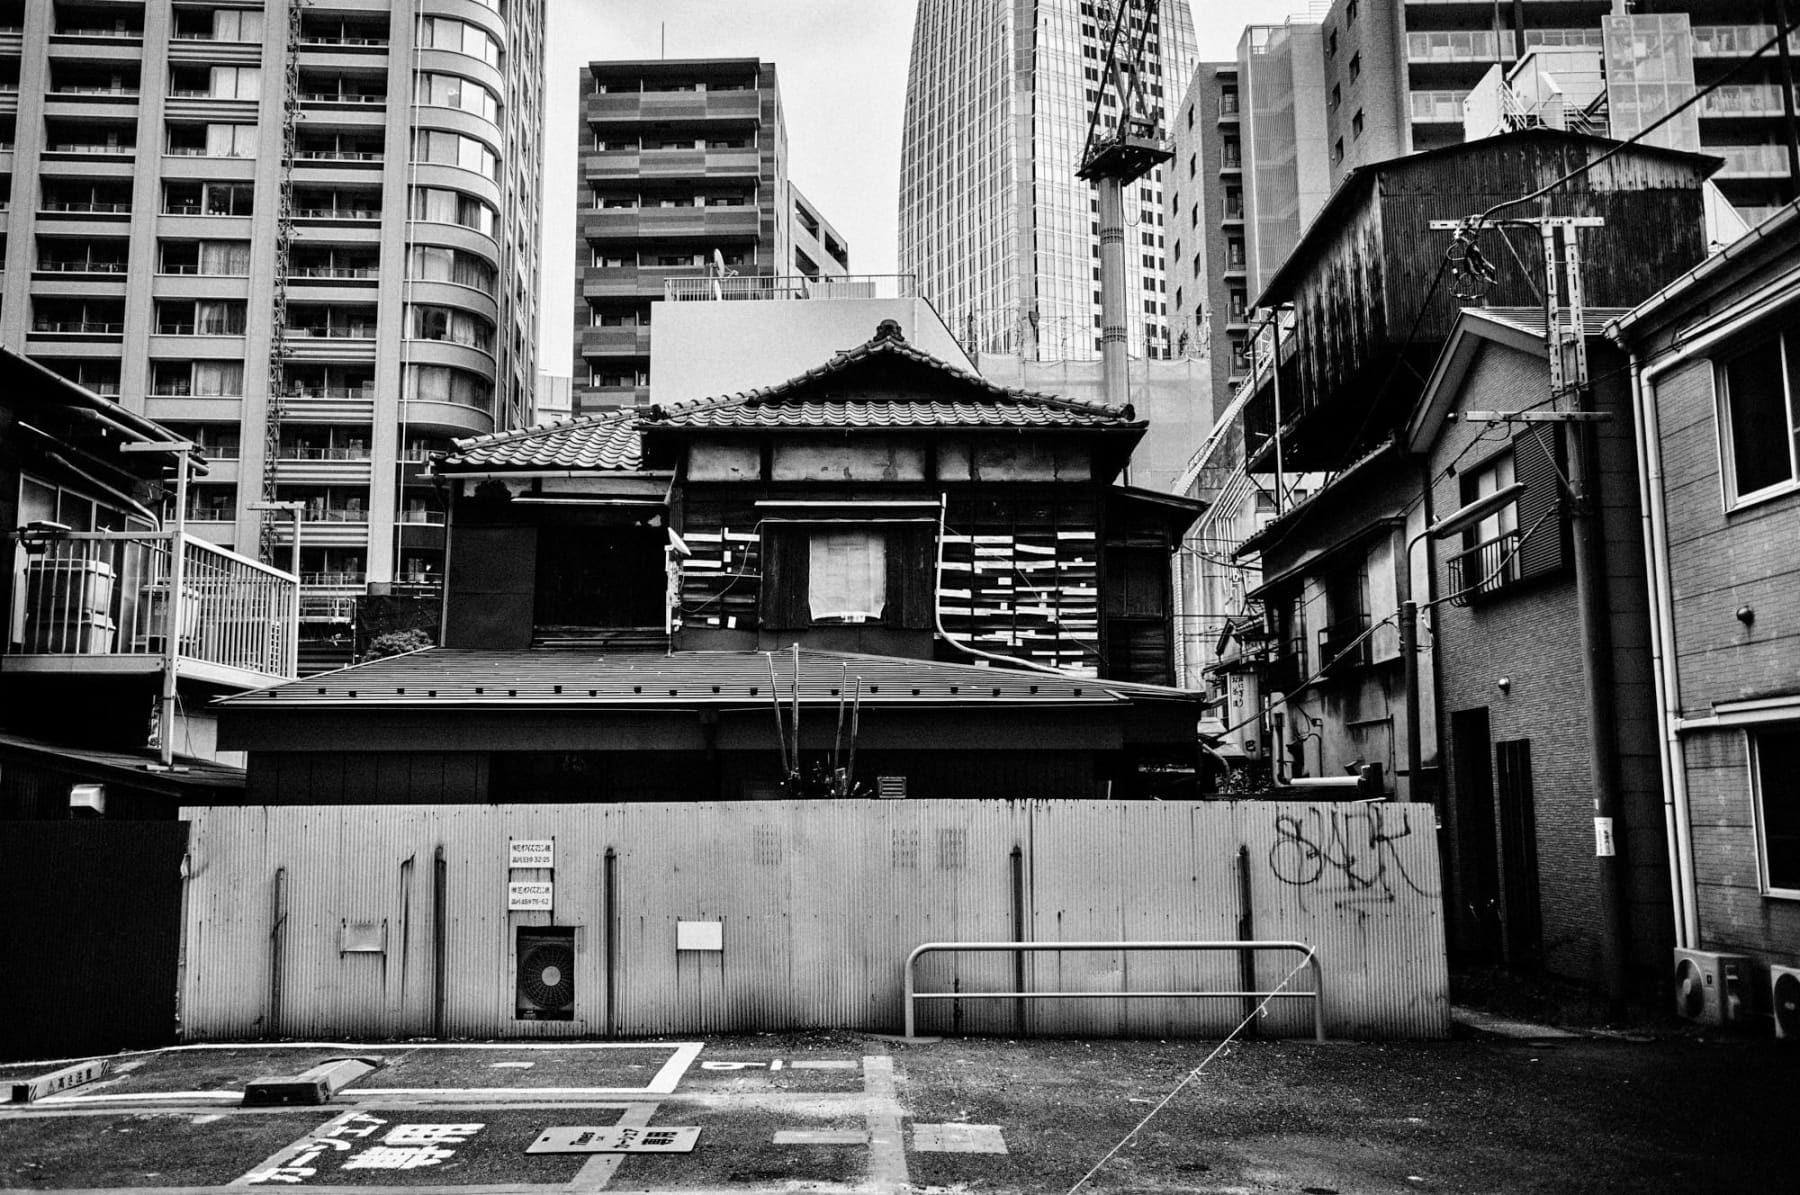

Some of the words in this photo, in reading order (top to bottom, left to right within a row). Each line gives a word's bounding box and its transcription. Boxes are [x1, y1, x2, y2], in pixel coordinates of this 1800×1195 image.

[244, 1112, 388, 1184] カーシェア
[340, 1123, 485, 1170] 専用
[612, 1128, 640, 1149] カーシェア
[641, 1131, 678, 1146] 専用
